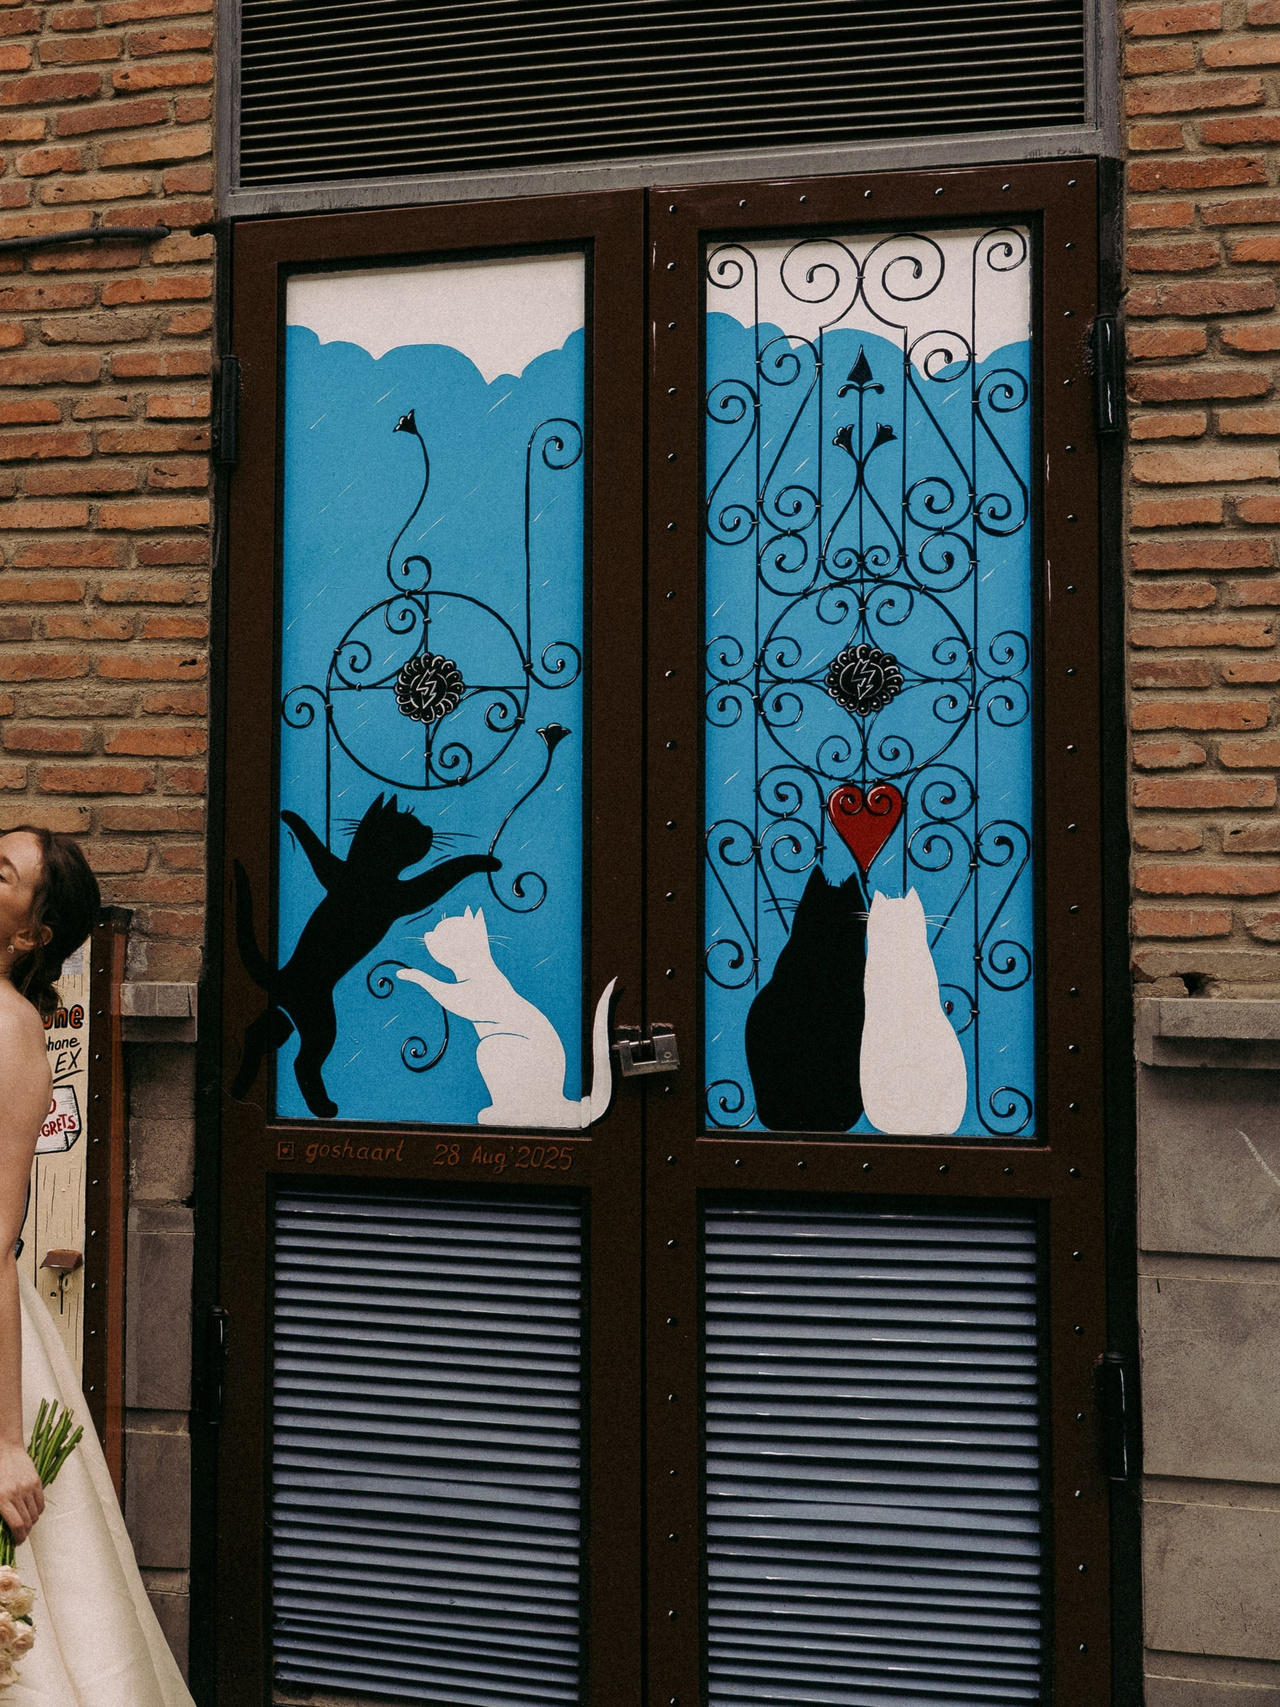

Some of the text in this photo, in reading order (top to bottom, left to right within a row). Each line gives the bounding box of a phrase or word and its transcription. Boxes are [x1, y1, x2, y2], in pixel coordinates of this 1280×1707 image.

[47, 1037, 80, 1052] hone
[55, 1048, 82, 1073] EX
[39, 1113, 76, 1137] GRETS
[305, 1138, 404, 1165] goshaart
[433, 1143, 461, 1167] 28
